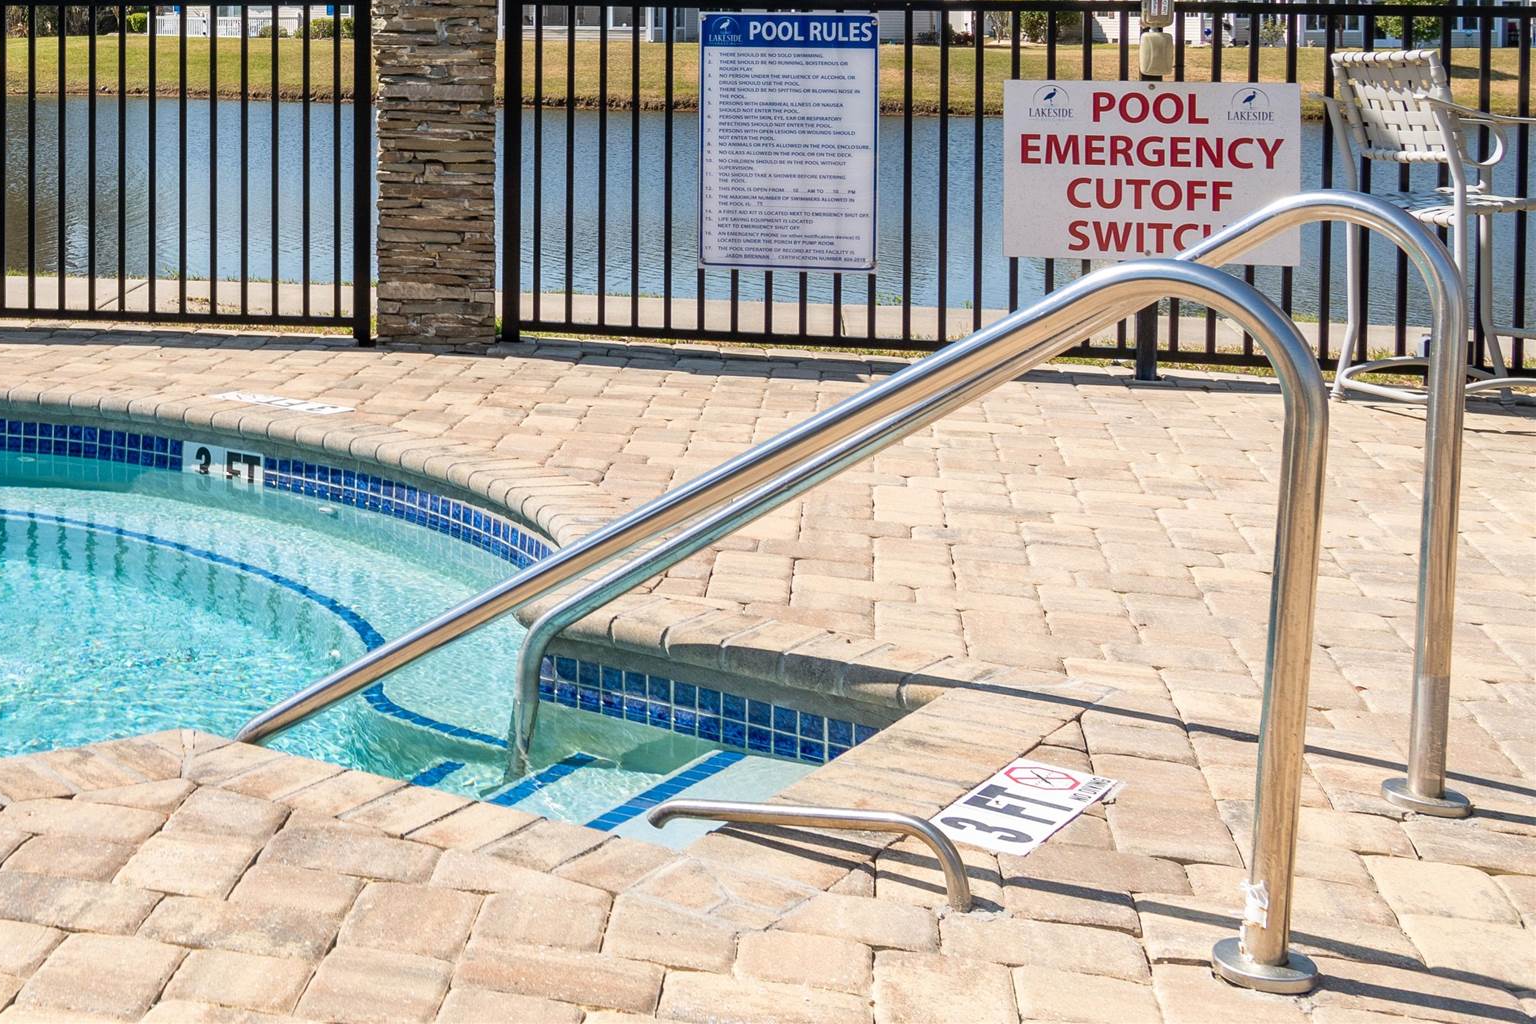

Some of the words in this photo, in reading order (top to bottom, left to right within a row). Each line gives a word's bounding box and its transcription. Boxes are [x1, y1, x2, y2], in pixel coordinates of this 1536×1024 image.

[709, 34, 742, 42] LAKESIDE
[749, 21, 805, 41] POOL
[810, 22, 873, 42] RULES
[1029, 108, 1073, 118] LAKESIDE
[1092, 91, 1209, 125] POOL
[1227, 111, 1274, 121] LAKESIDE
[1020, 133, 1285, 170] EMERGENCY
[1066, 177, 1233, 212] CUTOFF
[195, 446, 212, 474] 3
[226, 451, 261, 483] FT
[963, 783, 1074, 826] FT
[940, 816, 1034, 844] 3
